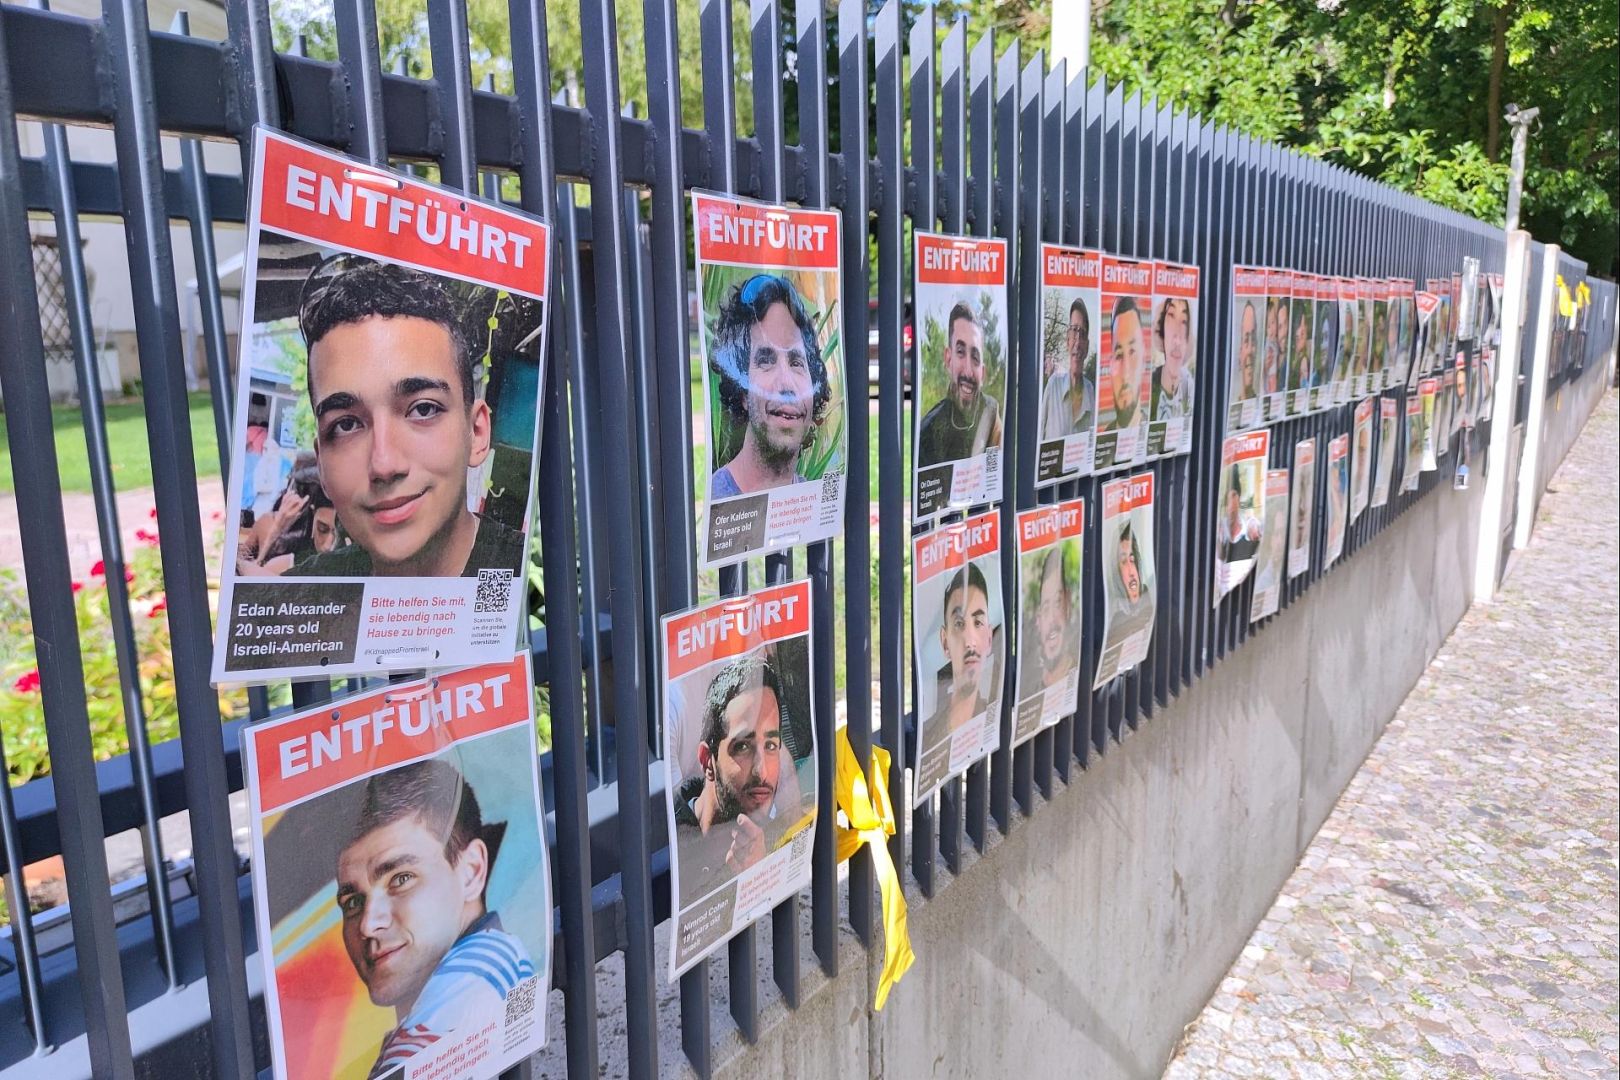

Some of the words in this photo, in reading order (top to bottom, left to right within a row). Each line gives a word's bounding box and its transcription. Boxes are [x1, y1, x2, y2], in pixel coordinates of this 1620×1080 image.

[285, 164, 532, 268] ENTFÜHRT
[705, 211, 829, 252] ENTFÜHRT
[1047, 255, 1099, 278] ENTFÜHRT
[1104, 264, 1151, 286] ENTFÜHRT
[723, 525, 741, 537] years
[741, 522, 752, 532] old
[238, 602, 275, 617] Edan
[277, 602, 346, 616] Alexander
[371, 597, 396, 608] Bitte
[398, 597, 429, 608] helfen
[431, 596, 447, 607] Sie
[448, 597, 467, 607] mit,
[369, 613, 385, 624] sie
[387, 611, 431, 624] lebendig
[432, 611, 456, 621] nach
[677, 595, 799, 658] ENTFÜHRT
[235, 623, 253, 637] 20
[256, 624, 295, 639] years
[298, 621, 320, 634] old
[367, 628, 400, 638] Hause
[401, 629, 414, 637] zu
[416, 626, 456, 638] bringen.
[233, 640, 344, 656] Israeli-American
[279, 673, 511, 779] ENTFÜHRT
[412, 1062, 433, 1079] Bitte
[436, 1043, 464, 1063] helfen
[466, 1033, 479, 1045] Sie
